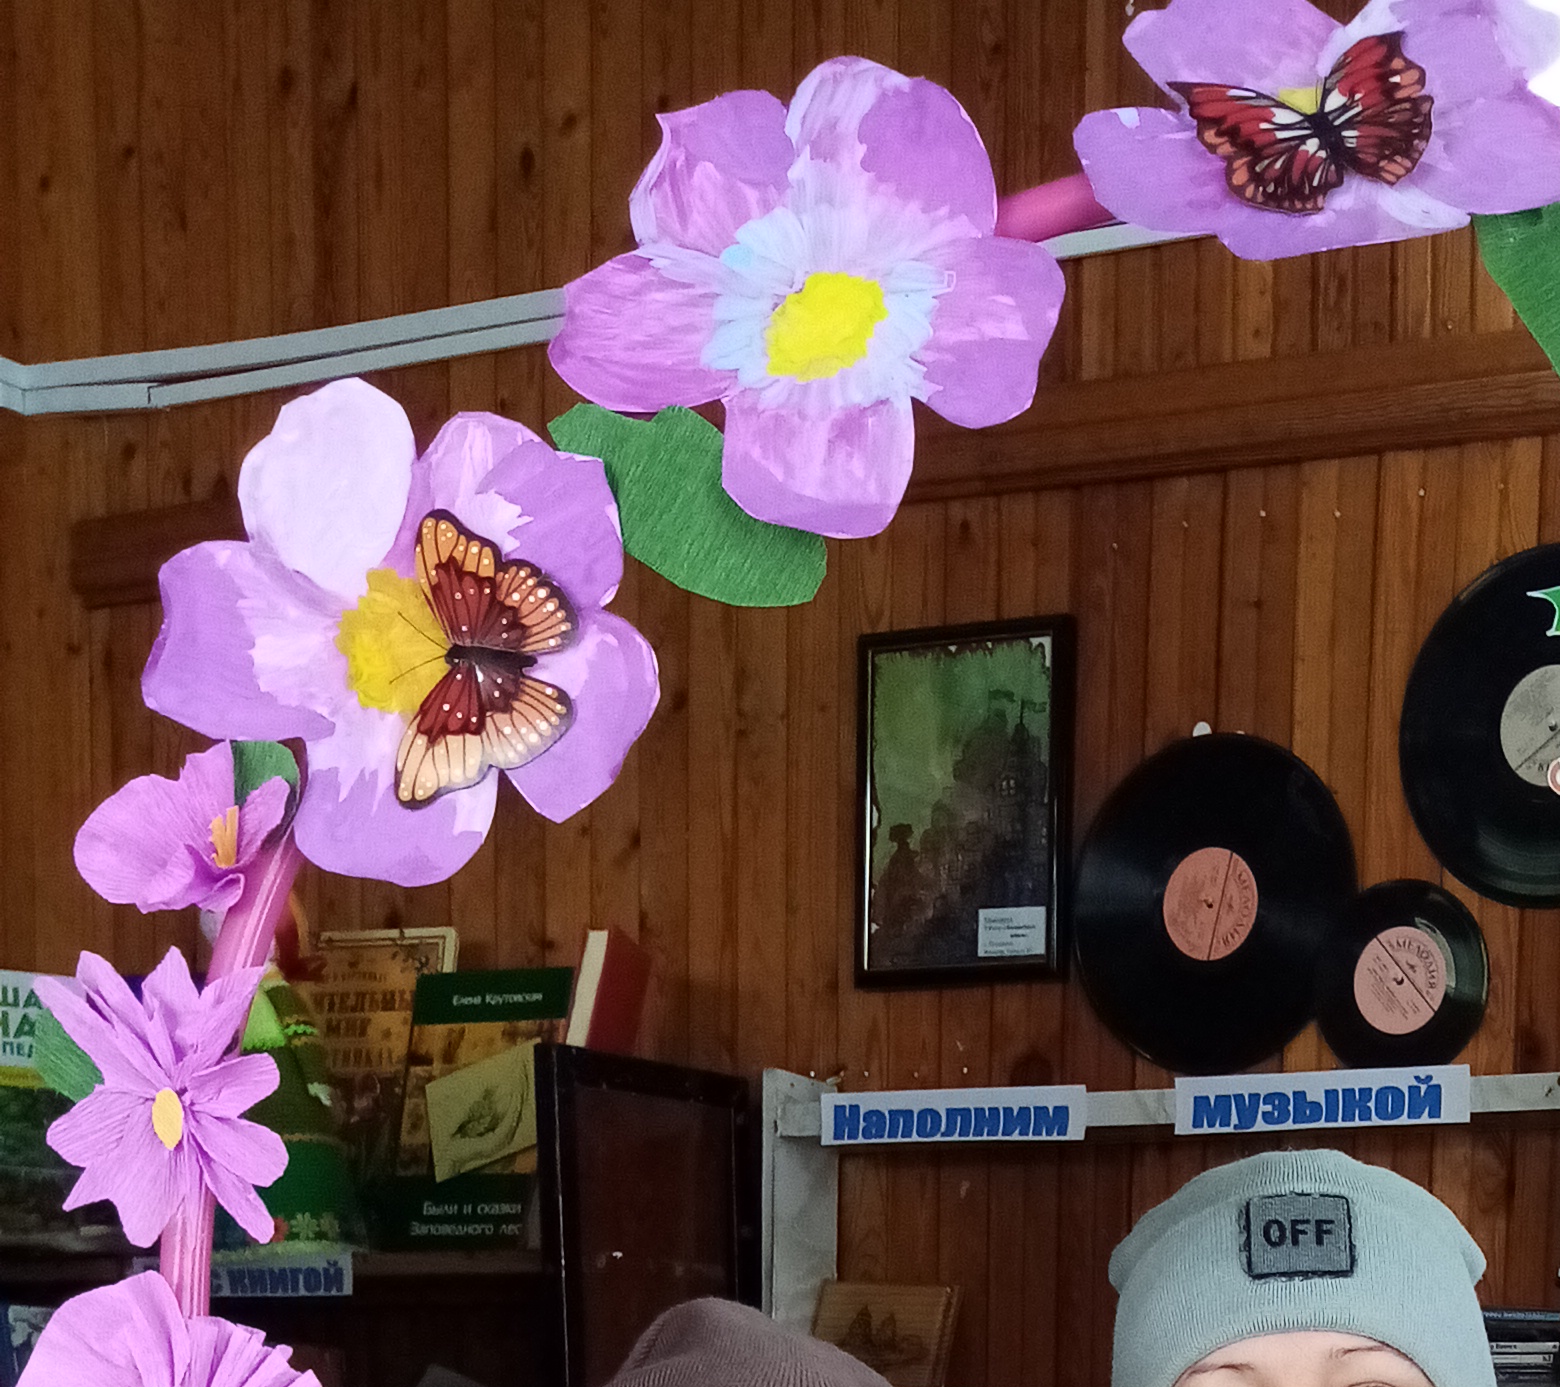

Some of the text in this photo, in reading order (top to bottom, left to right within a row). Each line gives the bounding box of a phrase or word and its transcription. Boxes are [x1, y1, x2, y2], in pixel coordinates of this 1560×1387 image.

[833, 1075, 1442, 1141] Наполним музыкой
[1262, 1219, 1336, 1248] OFF
[228, 1260, 345, 1294] книгой
